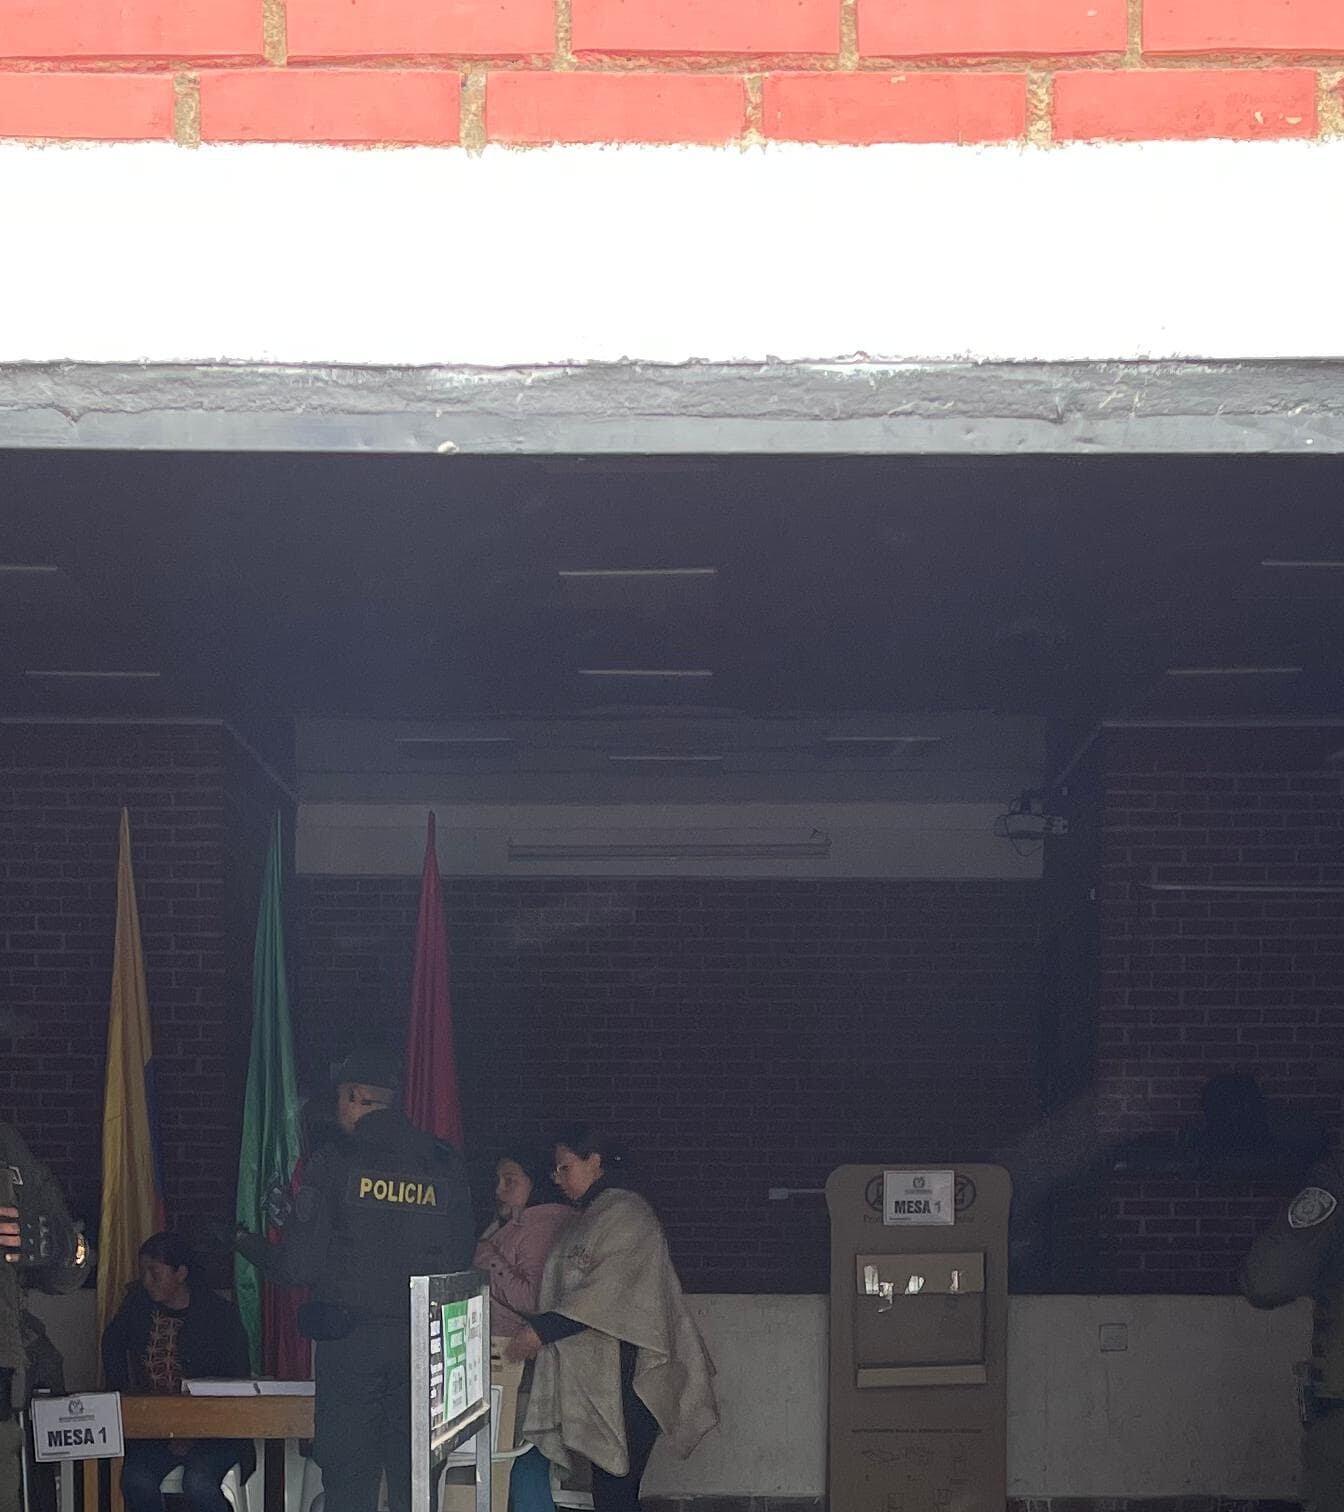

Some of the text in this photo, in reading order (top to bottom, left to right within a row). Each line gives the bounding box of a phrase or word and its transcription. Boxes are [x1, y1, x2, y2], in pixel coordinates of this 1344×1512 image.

[359, 1177, 438, 1207] POLICIA
[893, 1200, 932, 1215] MESA
[47, 1426, 107, 1448] MESA 1
